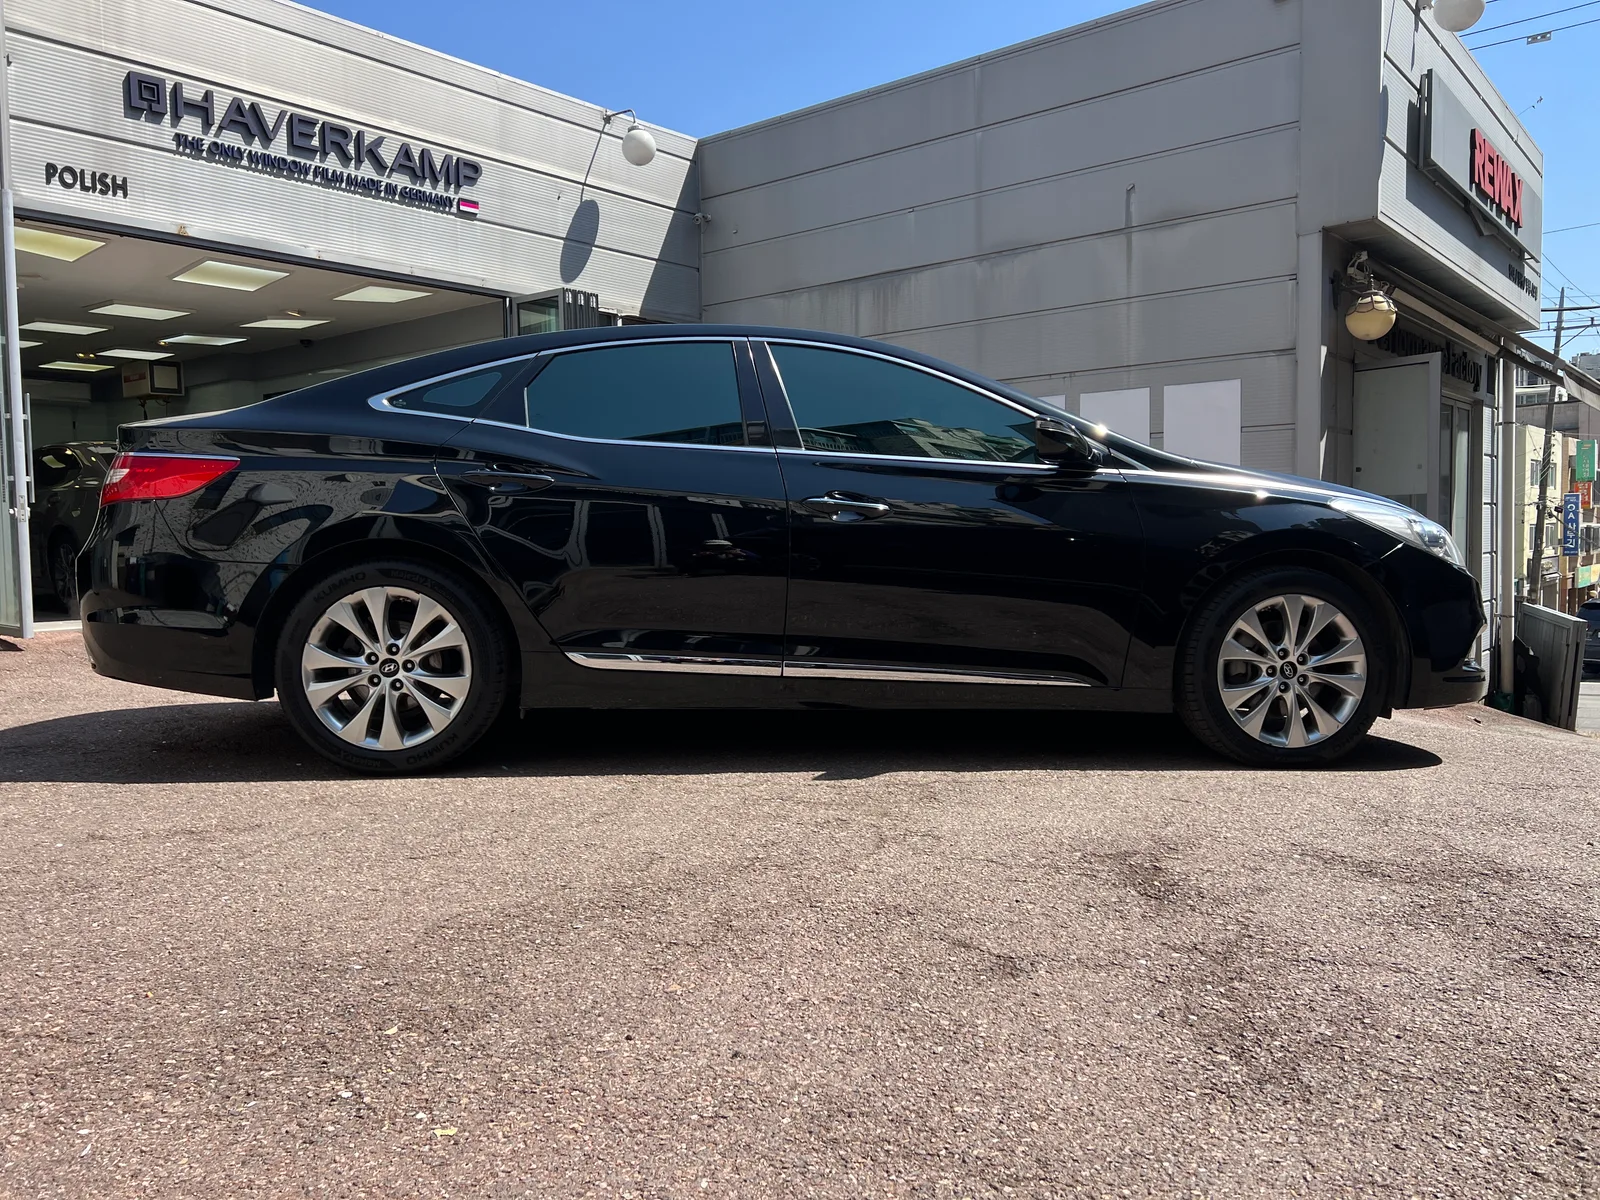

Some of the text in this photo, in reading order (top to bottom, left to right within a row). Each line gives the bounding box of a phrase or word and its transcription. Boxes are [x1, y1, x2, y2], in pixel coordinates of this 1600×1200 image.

[172, 82, 482, 188] HAVERKAMP
[175, 133, 457, 209] THE ONLY WINDOW FILM MADE IN GERMANY
[1471, 128, 1523, 228] REWAX
[45, 162, 128, 199] POLISH
